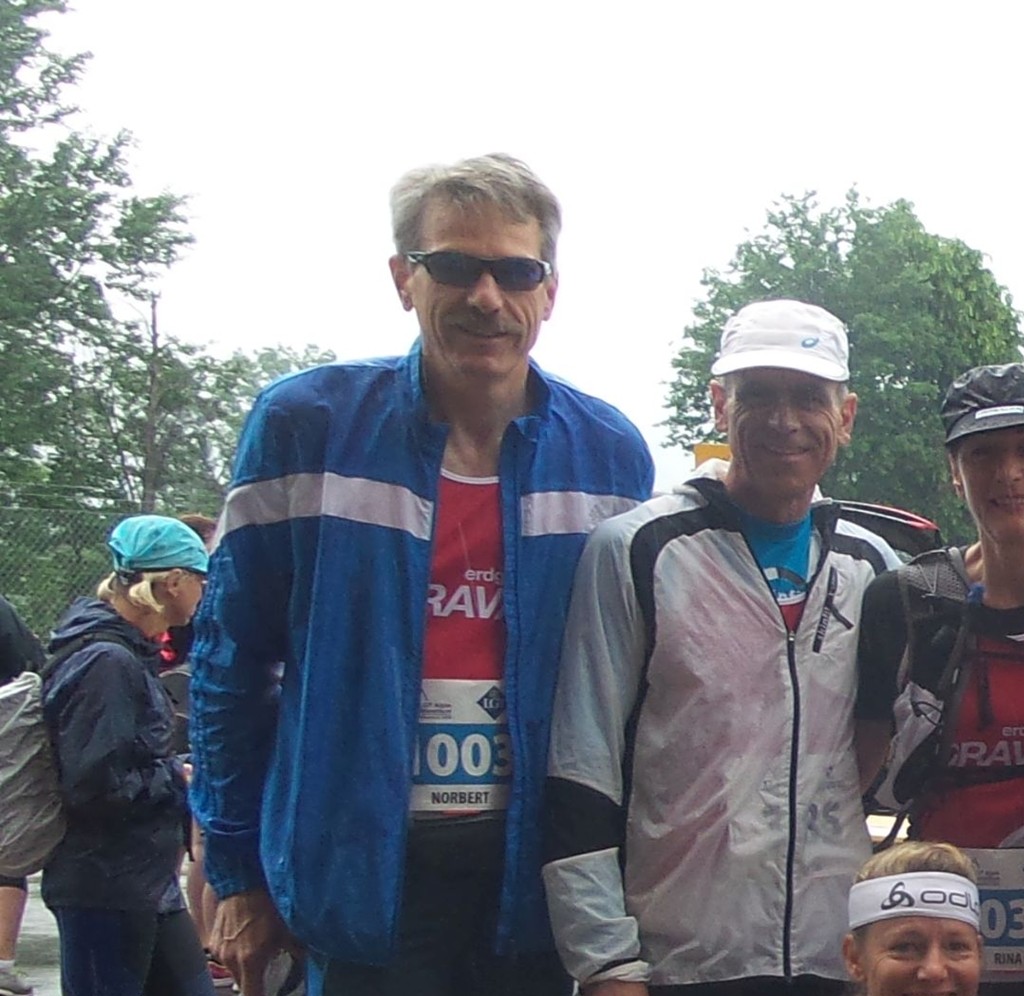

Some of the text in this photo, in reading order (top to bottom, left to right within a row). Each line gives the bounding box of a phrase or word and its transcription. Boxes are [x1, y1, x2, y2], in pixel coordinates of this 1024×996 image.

[431, 791, 490, 804] NORBERT
[920, 889, 980, 917] odl
[994, 953, 1023, 965] RINA
